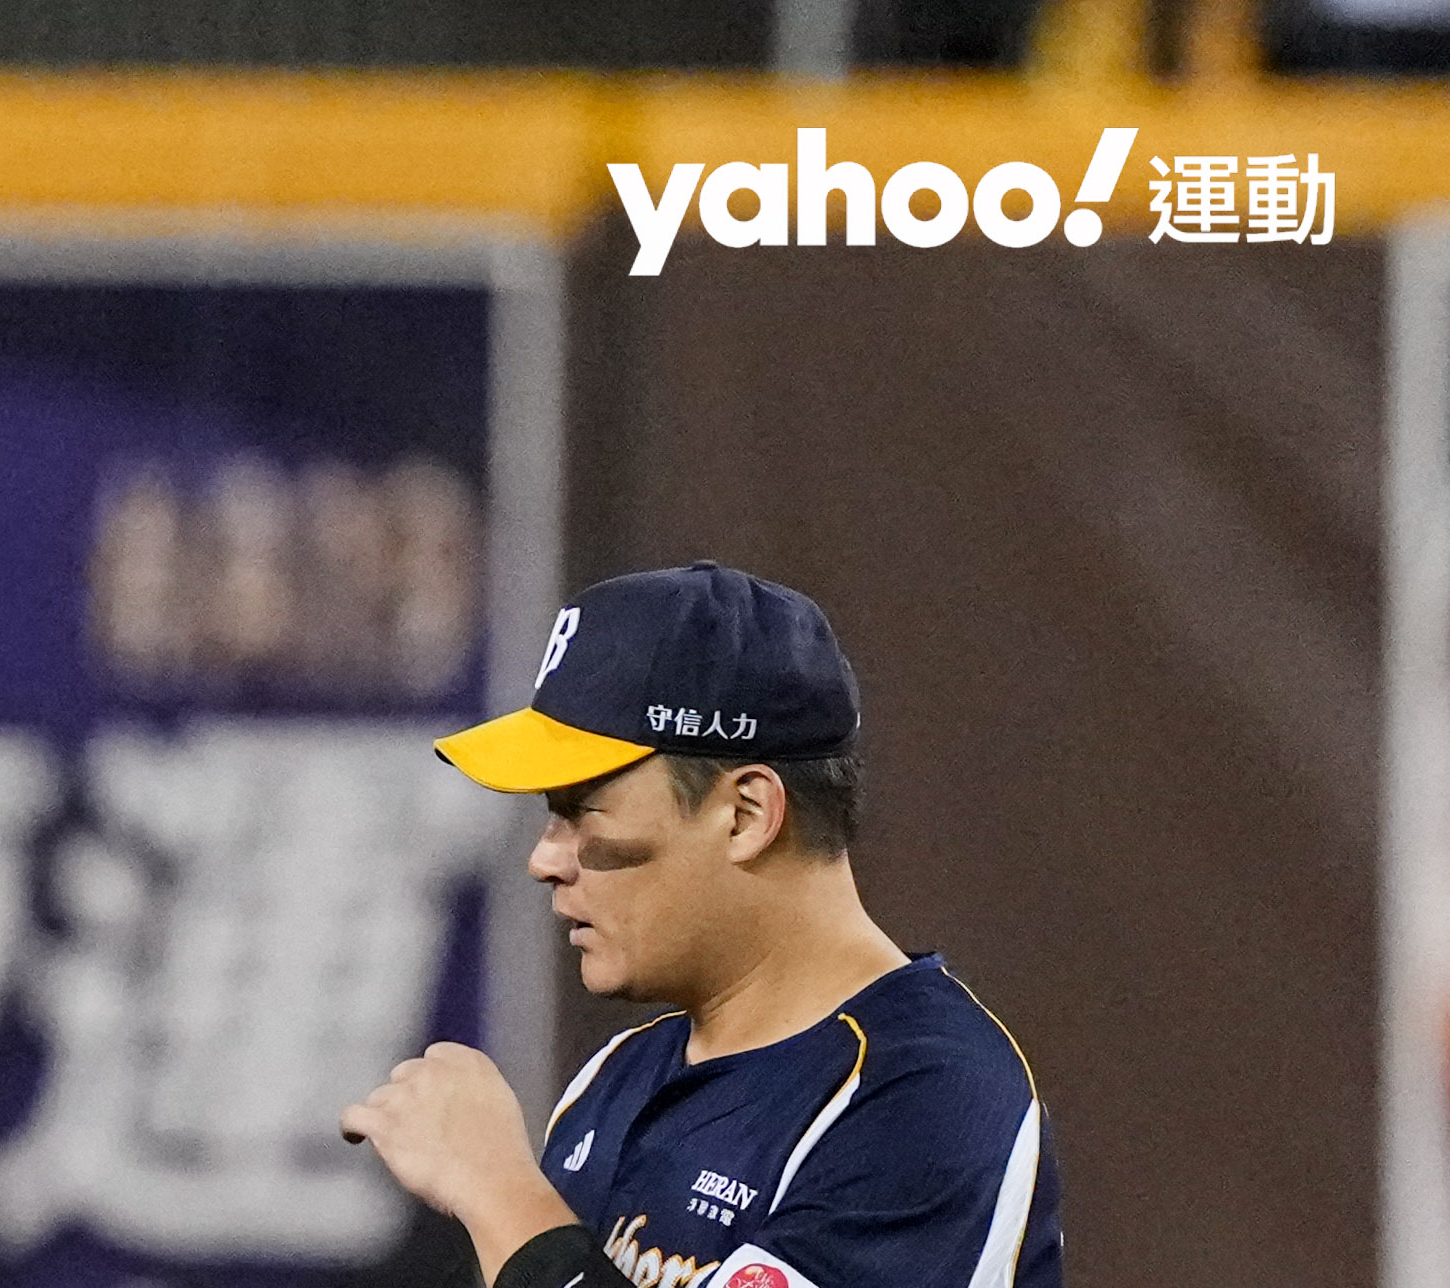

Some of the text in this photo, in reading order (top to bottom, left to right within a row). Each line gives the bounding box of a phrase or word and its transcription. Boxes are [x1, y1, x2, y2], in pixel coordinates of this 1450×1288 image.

[646, 704, 757, 741] 守信人力
[691, 1170, 758, 1210] HERAN
